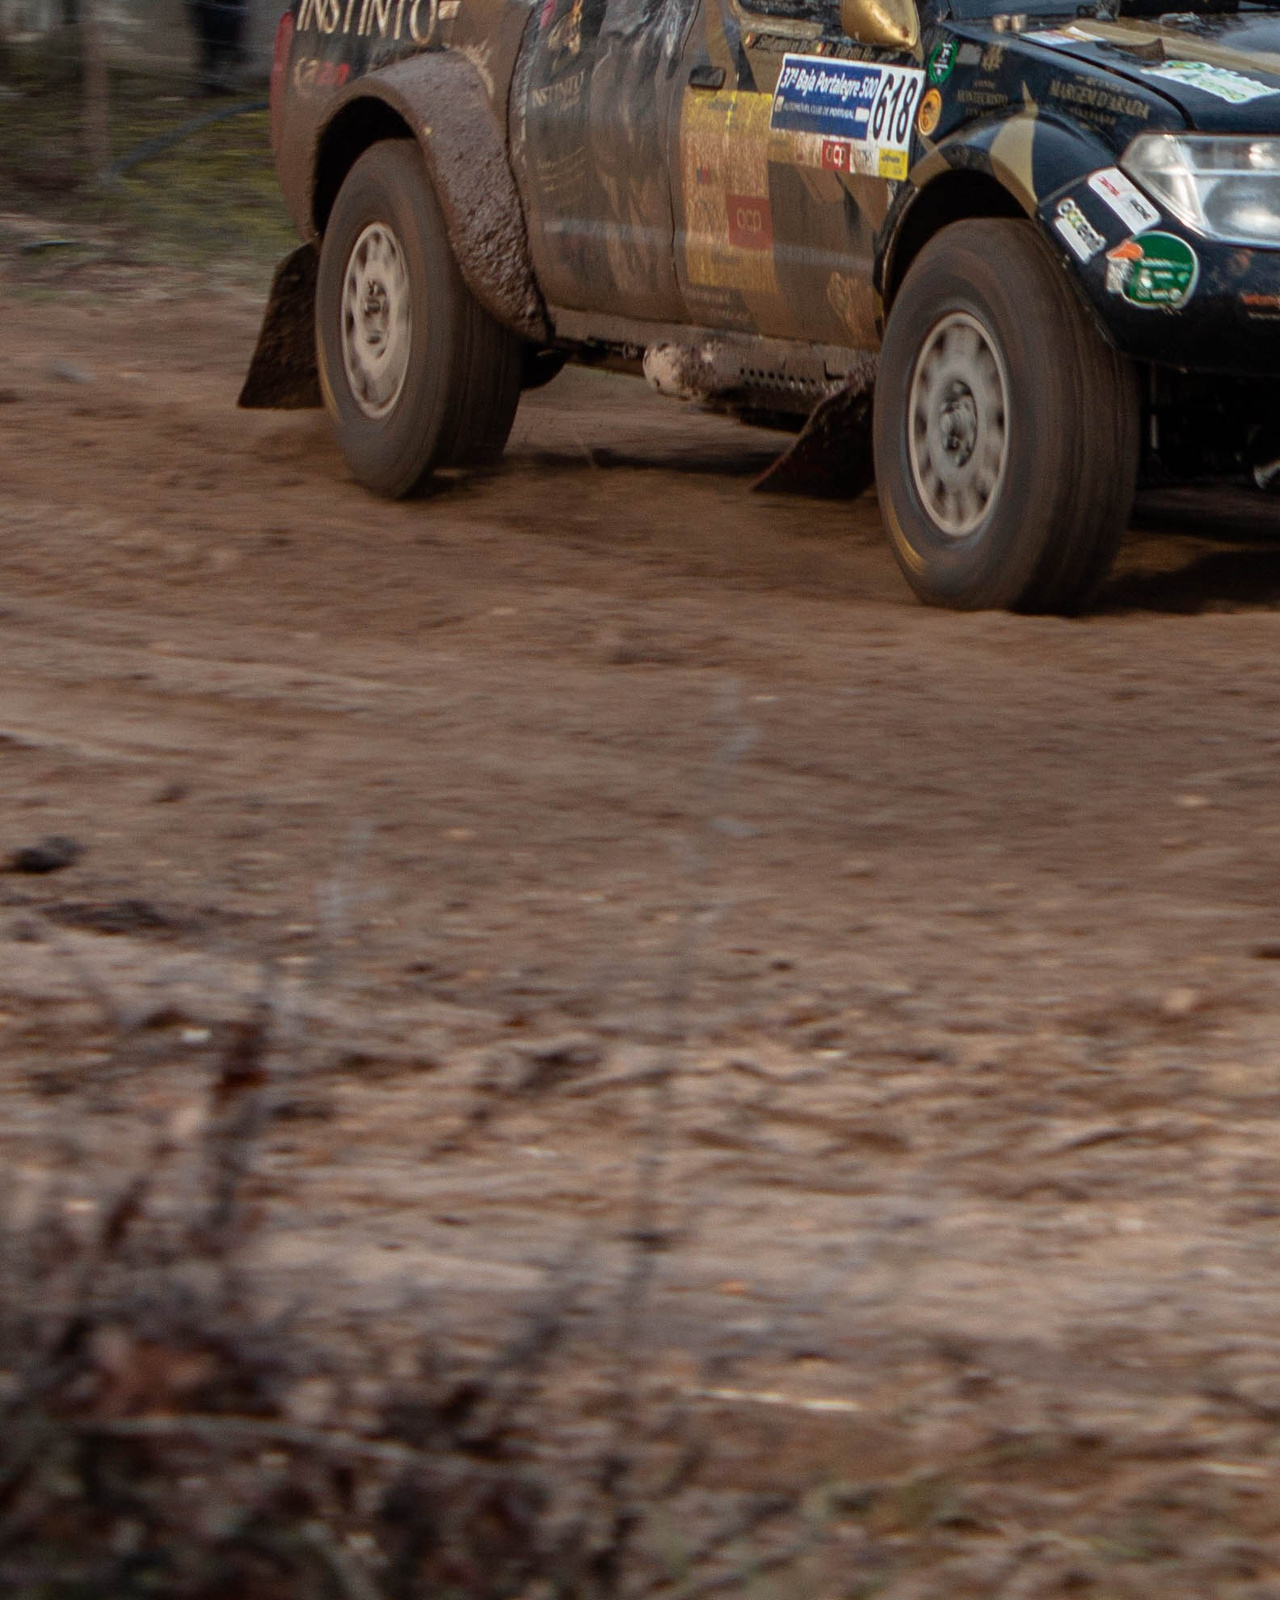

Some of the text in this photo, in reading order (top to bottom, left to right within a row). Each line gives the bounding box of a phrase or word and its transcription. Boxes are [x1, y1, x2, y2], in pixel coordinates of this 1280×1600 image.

[796, 68, 816, 96] Baja
[815, 70, 861, 102] Portalegre
[859, 75, 880, 100] 500
[873, 72, 919, 145] 618
